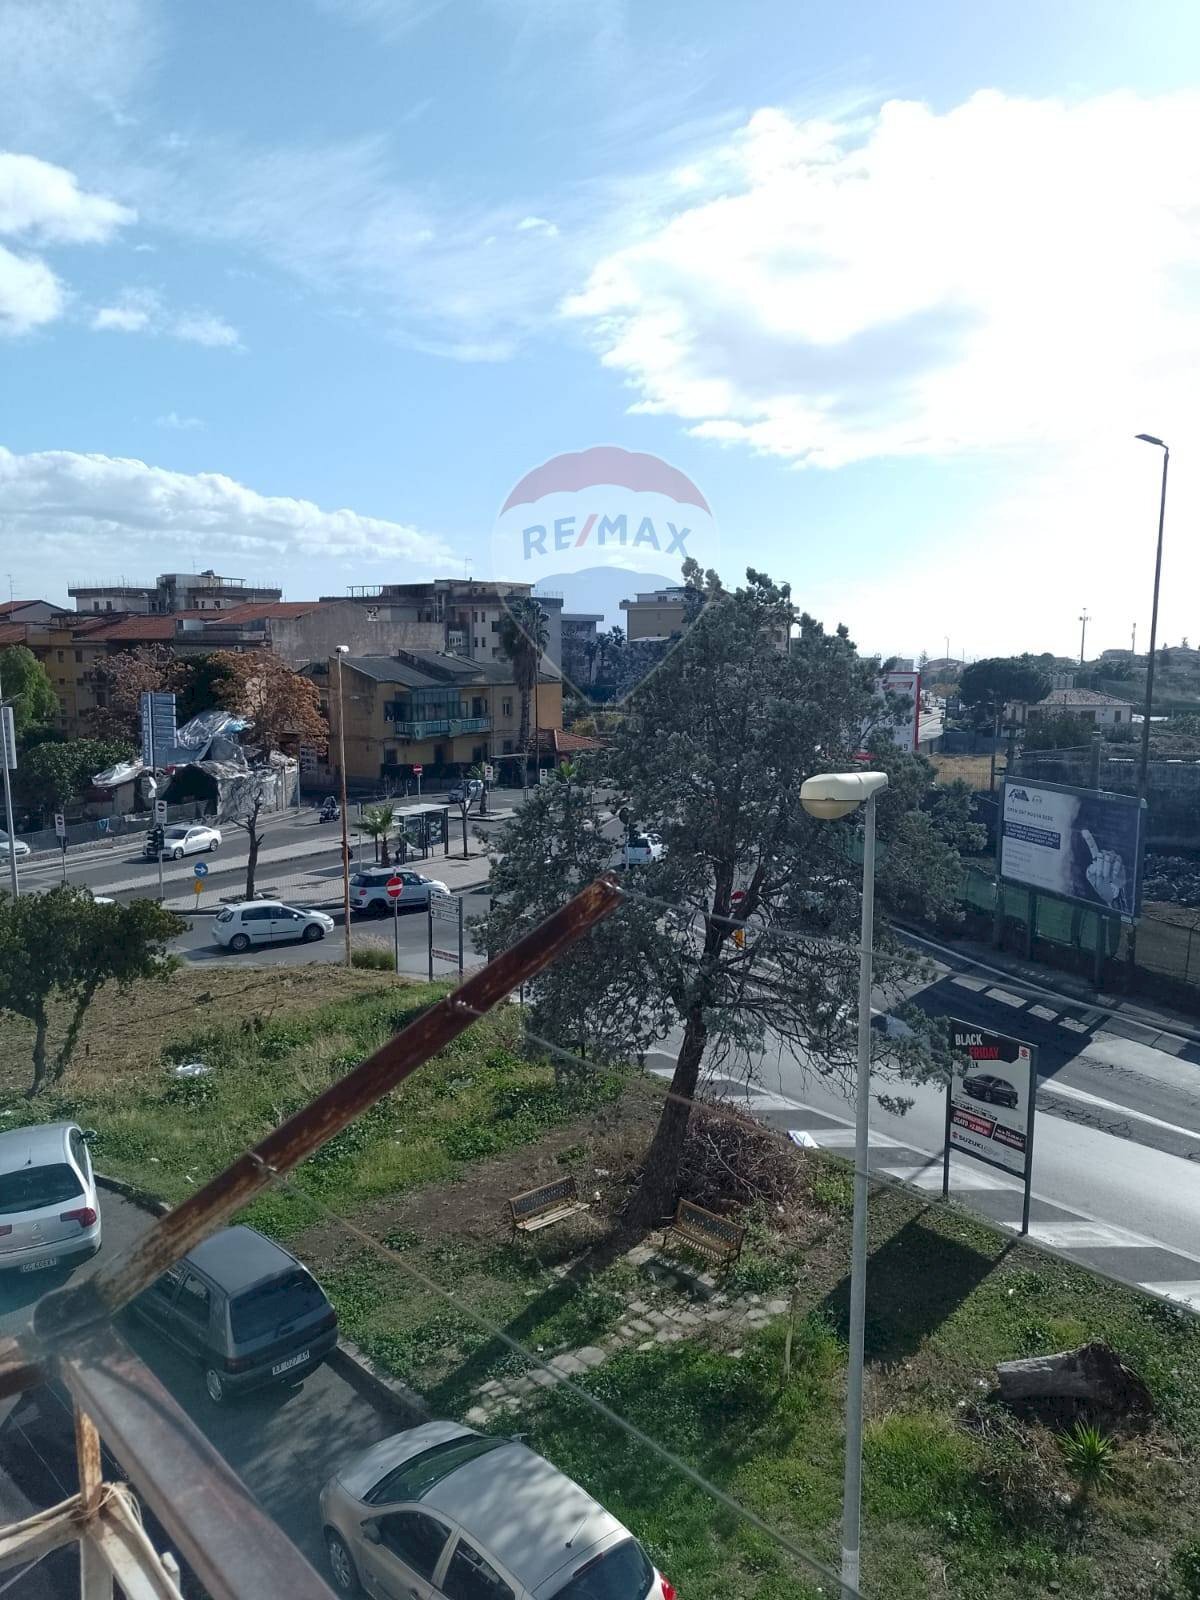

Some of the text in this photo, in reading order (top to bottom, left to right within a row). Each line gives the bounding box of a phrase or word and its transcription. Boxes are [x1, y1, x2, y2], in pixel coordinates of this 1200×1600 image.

[955, 1033, 983, 1046] BLACK
[969, 1046, 999, 1059] FRIDAY
[958, 1134, 984, 1150] SUZUKI
